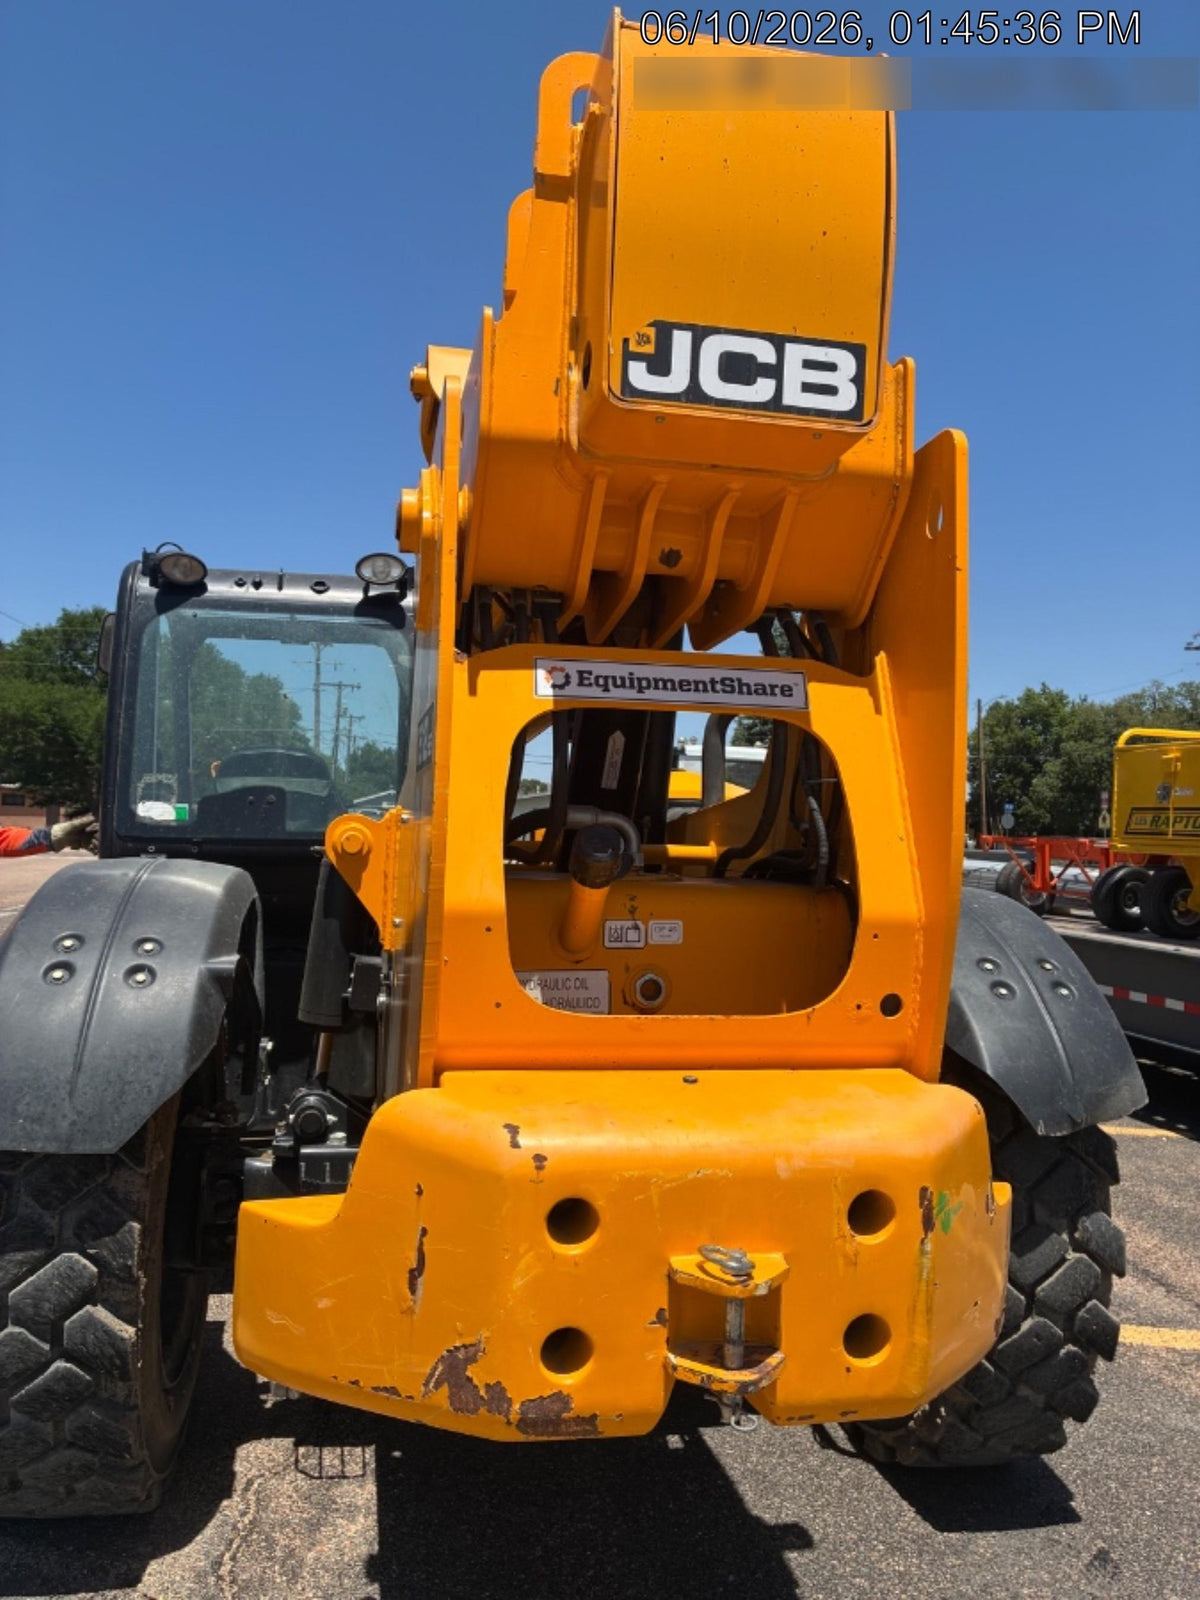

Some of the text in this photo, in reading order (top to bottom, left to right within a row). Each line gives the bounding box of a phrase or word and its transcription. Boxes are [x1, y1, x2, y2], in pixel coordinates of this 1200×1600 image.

[627, 329, 858, 412] JCB
[576, 669, 794, 698] EquipmentShare
[518, 977, 589, 991] YDRAULIC OIL
